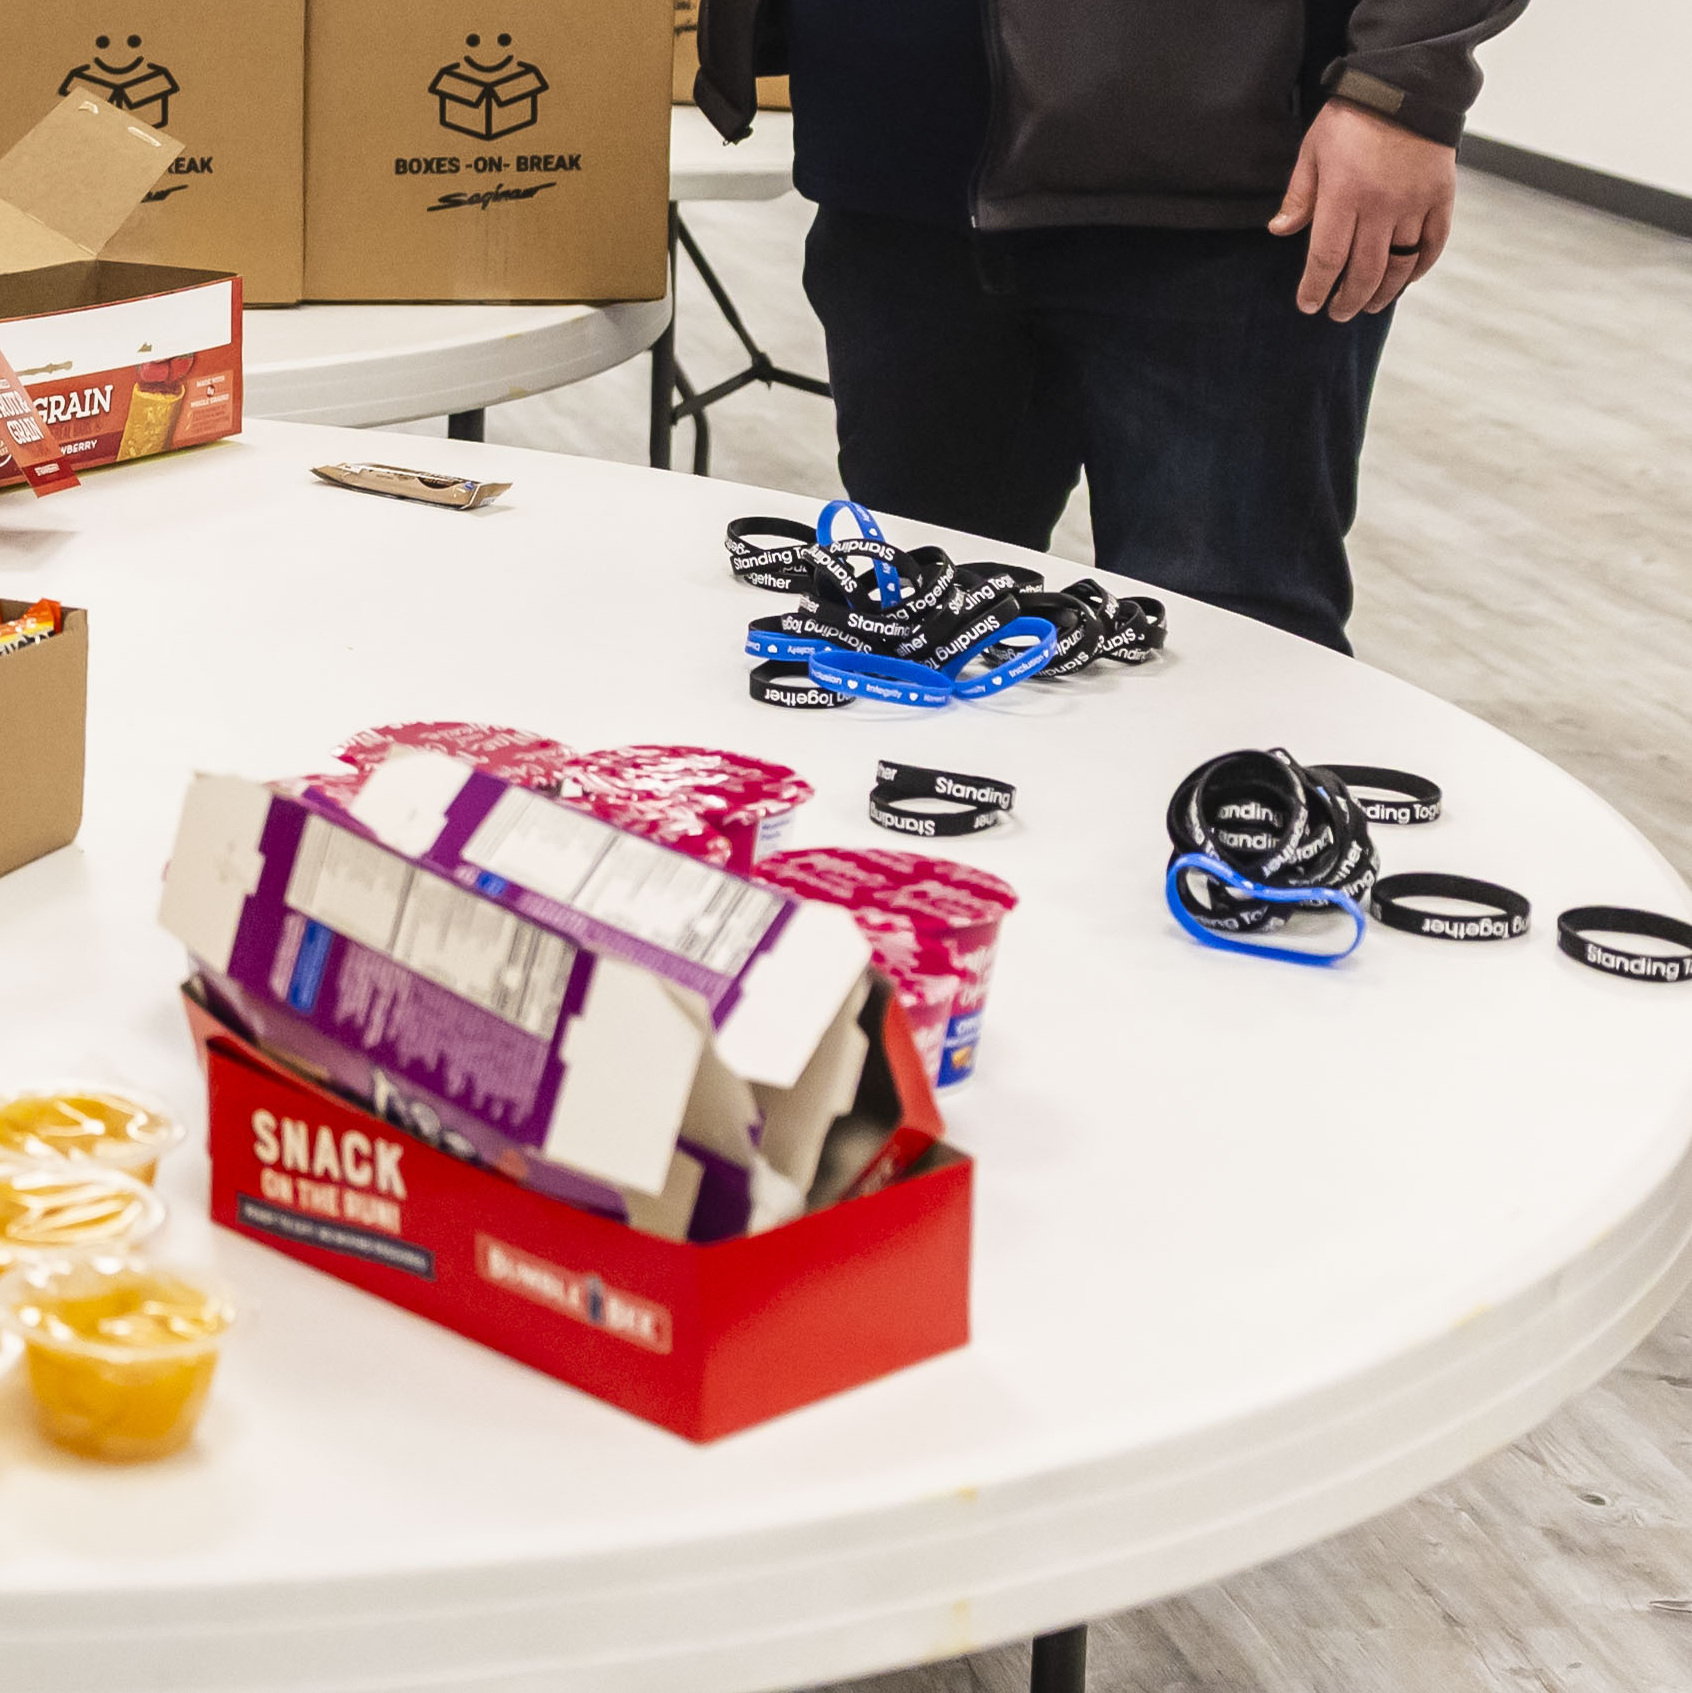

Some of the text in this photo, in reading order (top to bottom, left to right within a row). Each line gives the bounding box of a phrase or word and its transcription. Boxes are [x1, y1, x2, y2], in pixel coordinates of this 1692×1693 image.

[394, 157, 460, 175] BOXES
[516, 153, 582, 173] BREAK
[33, 385, 113, 425] GRAIN
[733, 547, 792, 571] Standing
[830, 540, 896, 561] Standing
[907, 563, 955, 613] Together
[935, 615, 1001, 662] Standing
[764, 687, 834, 708] Together
[935, 776, 1011, 810] Standing
[1421, 917, 1509, 940] Together
[1586, 942, 1680, 982] Standing
[250, 1107, 407, 1201] SNACK
